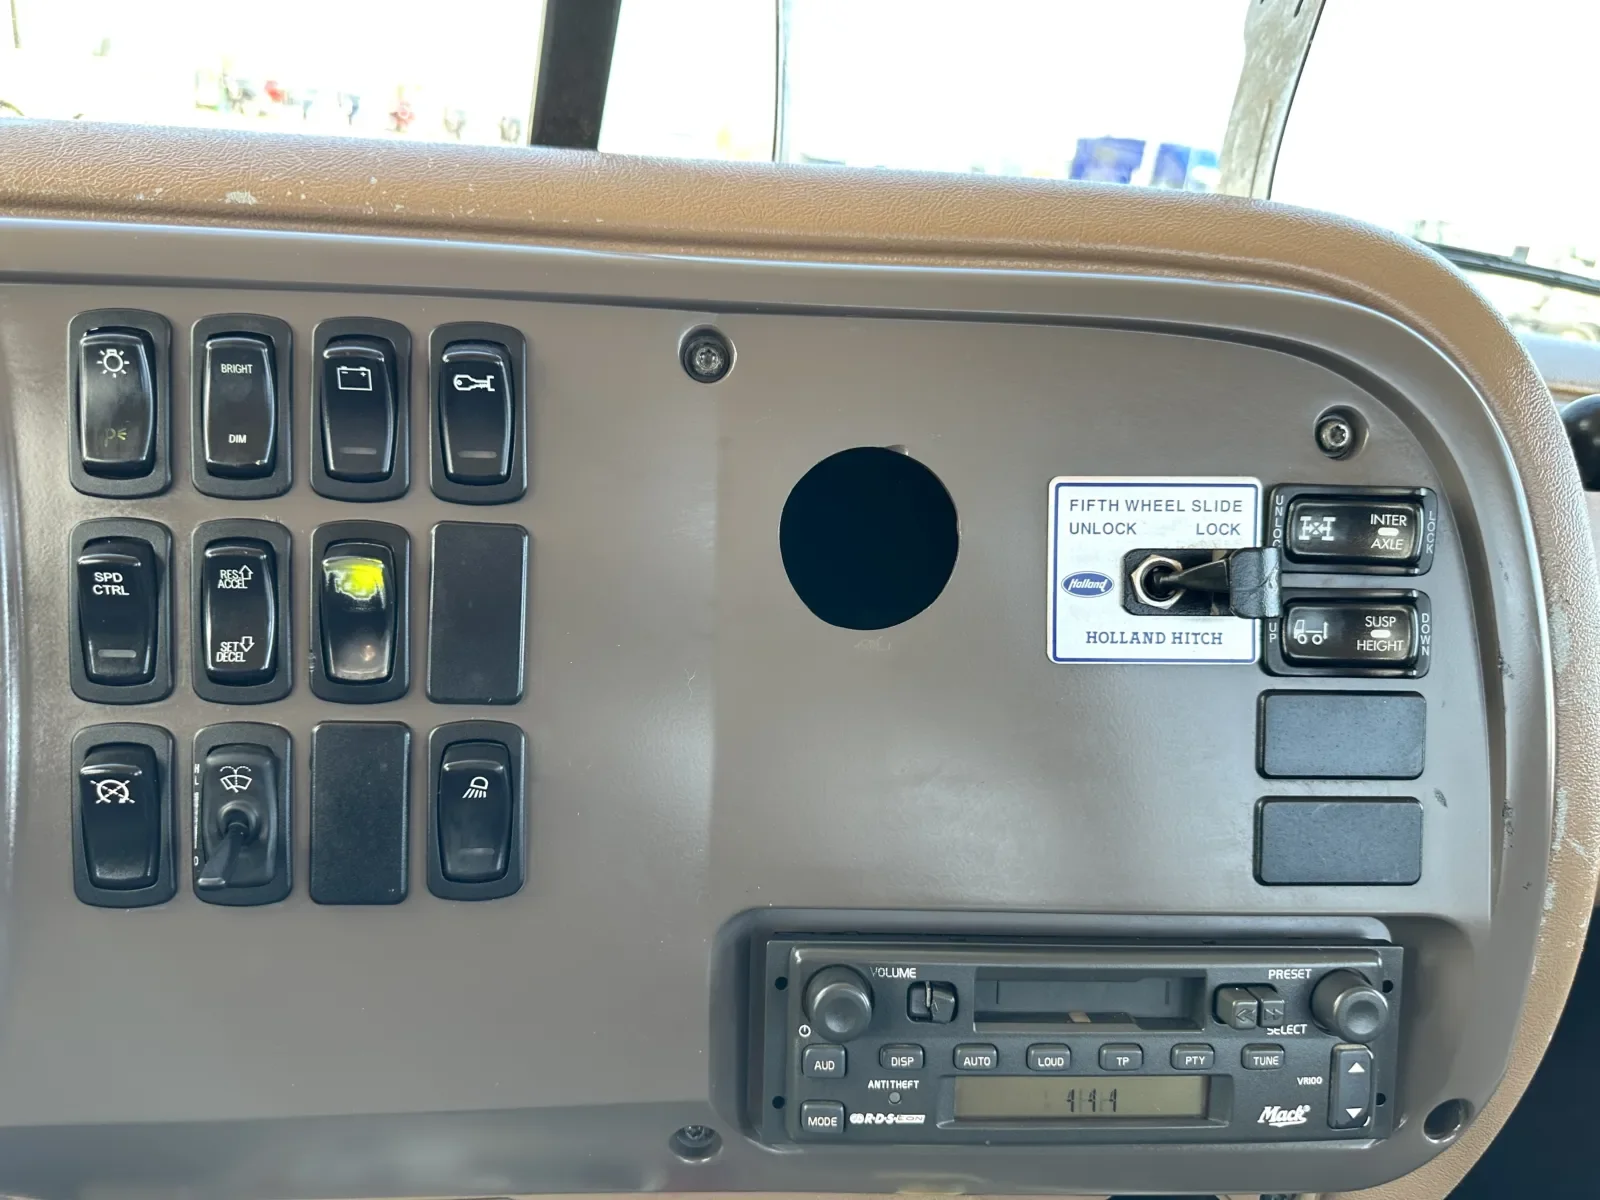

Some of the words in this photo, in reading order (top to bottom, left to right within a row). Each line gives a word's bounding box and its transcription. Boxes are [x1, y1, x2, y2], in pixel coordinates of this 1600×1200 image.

[220, 364, 252, 374] BRIGHT
[228, 434, 246, 444] DIM
[1069, 500, 1119, 512] FIFTH
[1125, 500, 1185, 512] WHEEL
[1191, 500, 1243, 512] SLIDE
[1272, 495, 1284, 547] UNLOC
[1370, 514, 1407, 526] INTER
[1069, 522, 1137, 534] UNLOCK
[1196, 523, 1240, 536] LOCK
[1426, 510, 1436, 554] LOCK
[1370, 539, 1404, 550] AXLE
[94, 572, 122, 582] SPD
[217, 579, 248, 588] ACCEL
[1067, 578, 1108, 592] Holland
[92, 585, 130, 596] CTRL
[1365, 616, 1396, 628] SUSP
[1268, 622, 1278, 642] UP
[1420, 613, 1430, 656] DOWN
[1086, 632, 1166, 644] HOLLAND
[1171, 632, 1223, 644] HITCH
[220, 641, 240, 652] SET
[1356, 640, 1404, 652] HEIGHT
[216, 652, 246, 662] DECEL
[870, 967, 916, 978] VOLUME
[1268, 969, 1312, 980] PRESET
[814, 1060, 835, 1070] AUD
[891, 1056, 914, 1066] DISP
[964, 1056, 991, 1066] AUTO
[1038, 1057, 1064, 1067] LOUD
[1116, 1056, 1130, 1067] TP
[1186, 1056, 1206, 1065] PTY
[1254, 1056, 1279, 1066] TUNE
[1257, 1105, 1310, 1127] Mack
[808, 1117, 838, 1127] MODE
